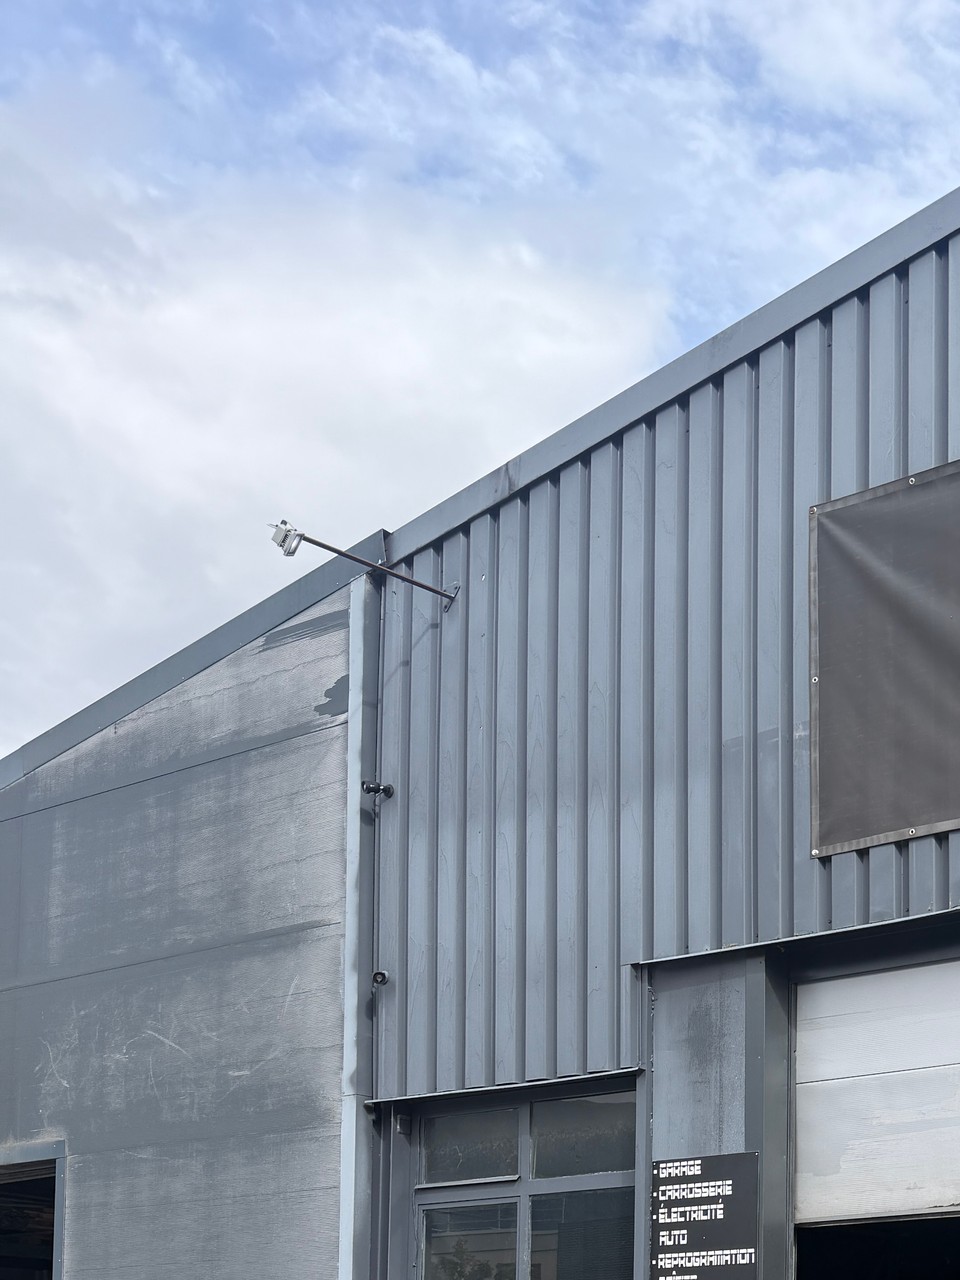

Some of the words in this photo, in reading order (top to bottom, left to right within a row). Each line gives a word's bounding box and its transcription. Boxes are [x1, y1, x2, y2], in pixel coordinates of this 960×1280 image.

[659, 1160, 702, 1178] GARAGE
[658, 1180, 733, 1201] CARROSSERIE
[658, 1198, 724, 1223] ÉLECTRICITÉ
[659, 1229, 688, 1246] AUTO
[658, 1248, 755, 1269] REPROGRAMATION
